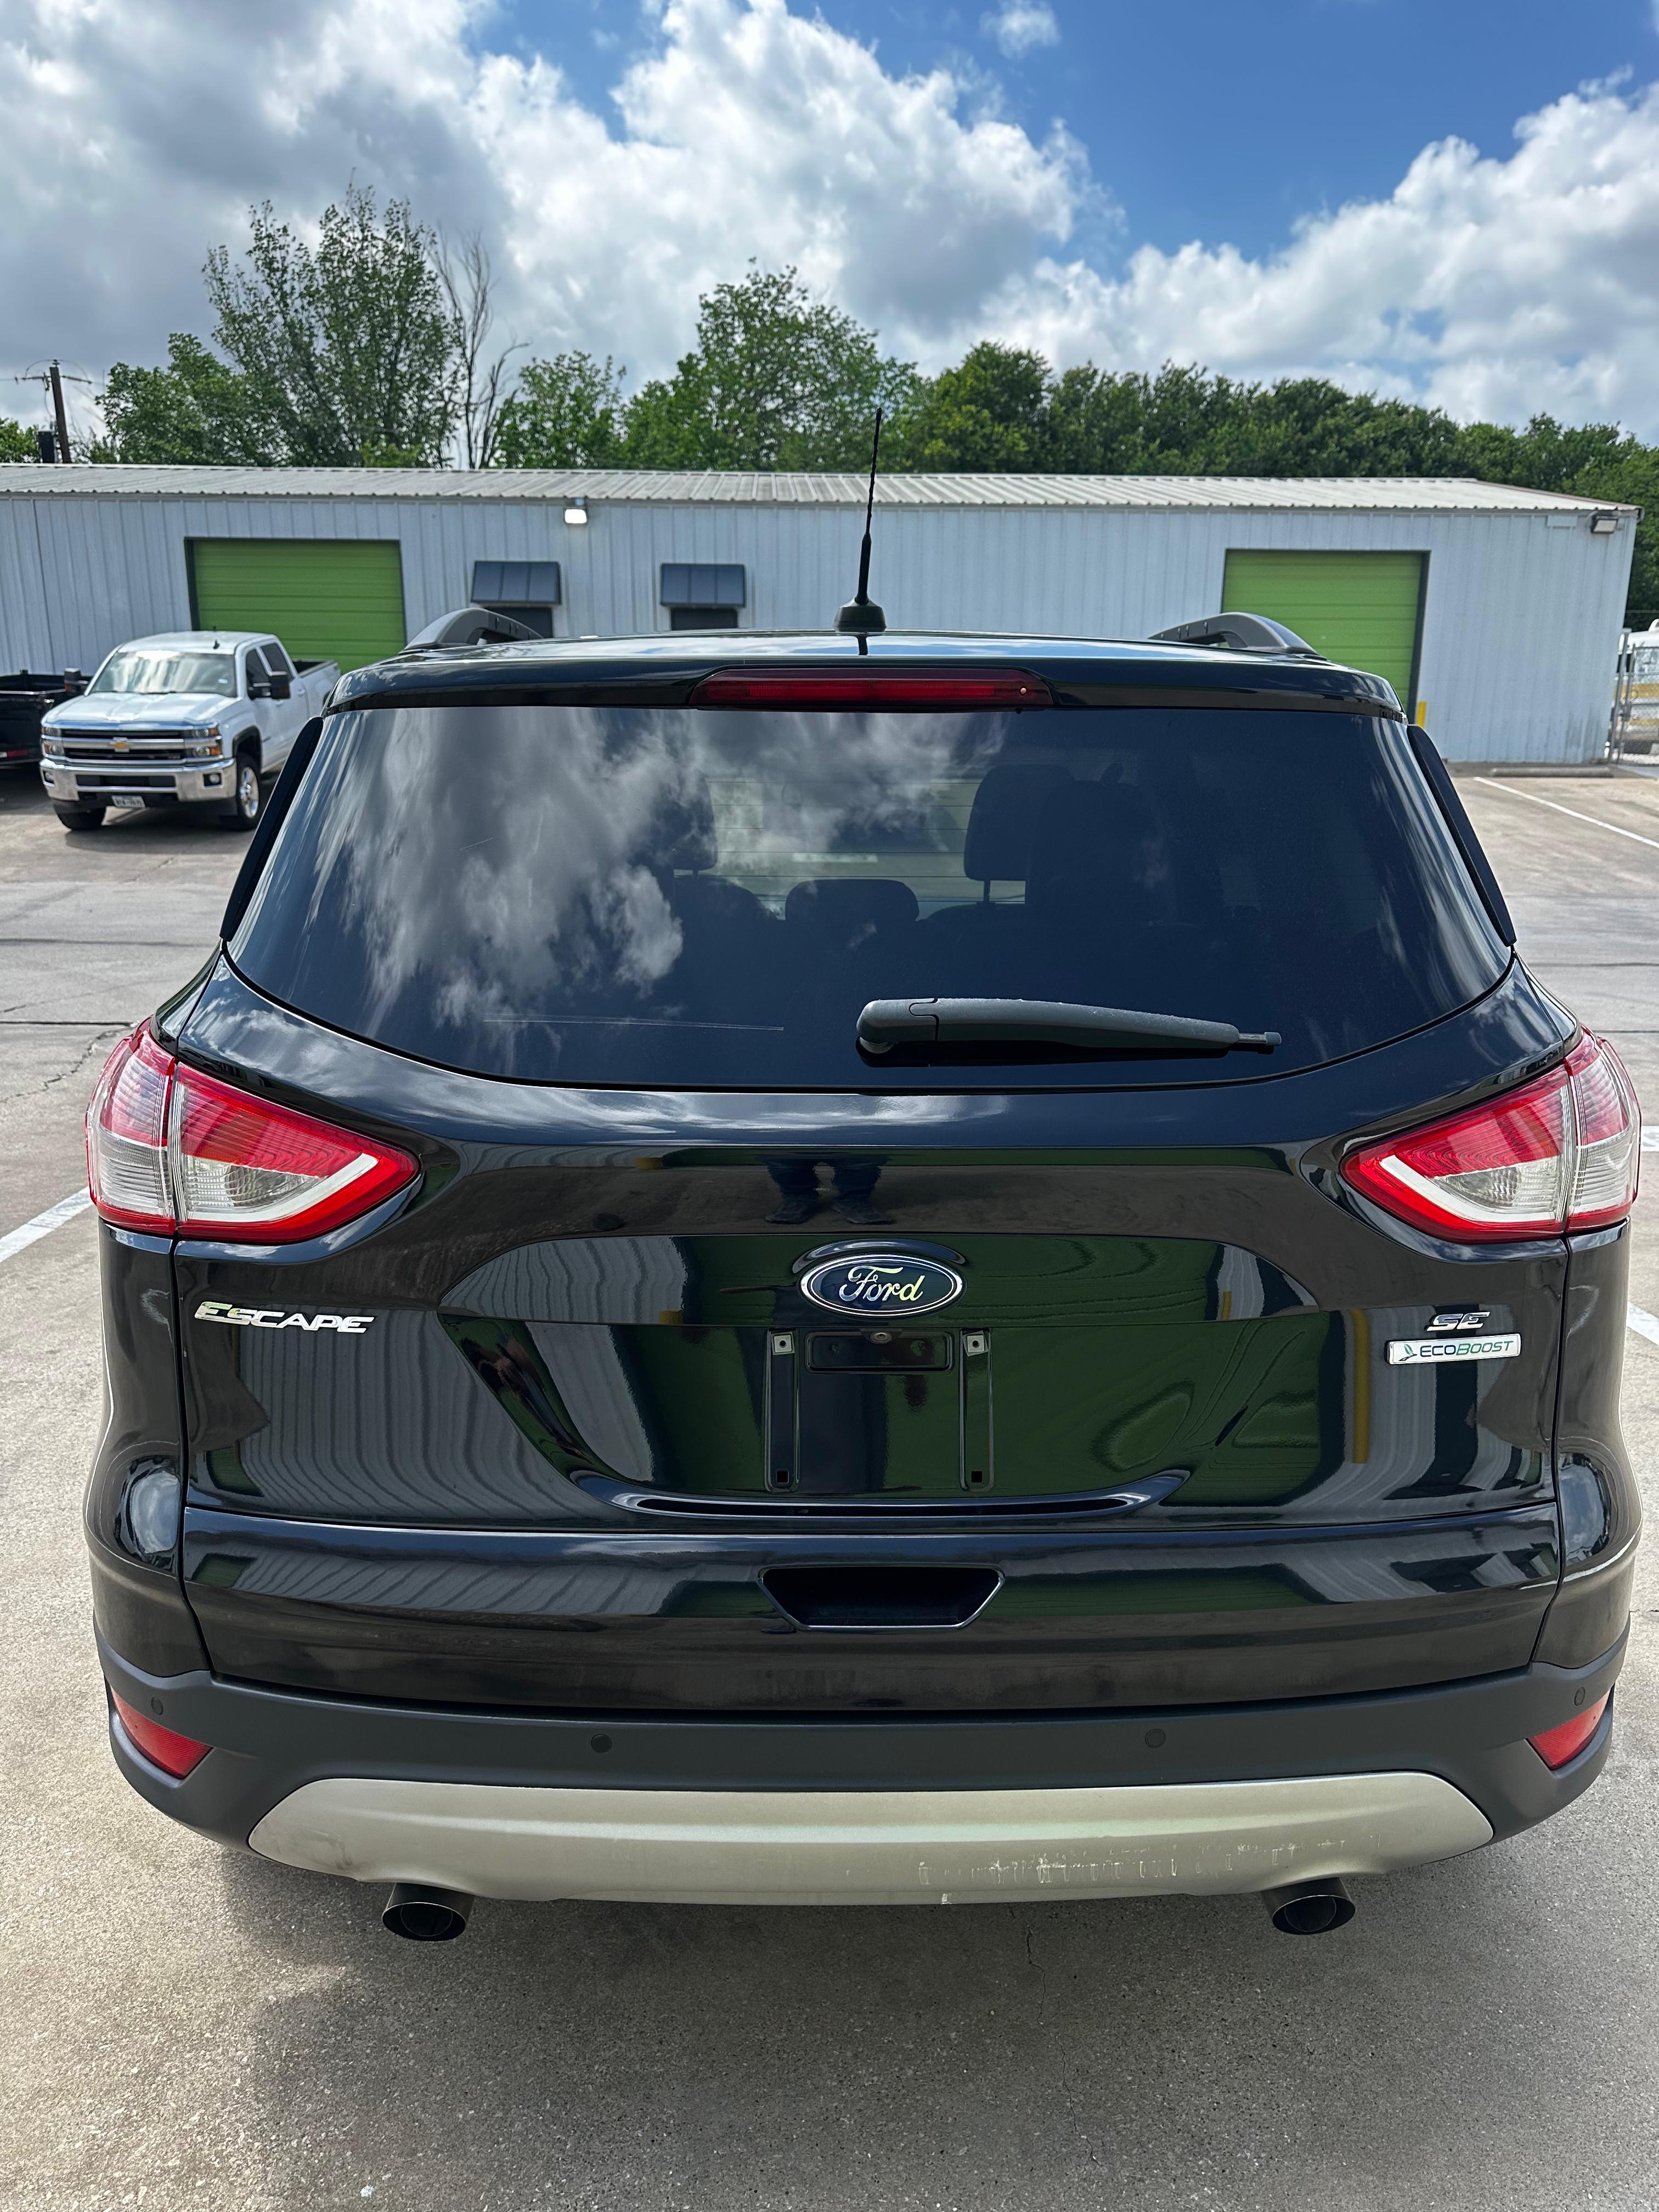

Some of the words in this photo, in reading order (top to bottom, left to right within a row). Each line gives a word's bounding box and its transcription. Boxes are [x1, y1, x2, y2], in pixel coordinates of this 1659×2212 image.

[839, 1265, 926, 1301] Ford
[194, 1301, 375, 1333] ESCAPE
[1426, 1311, 1491, 1331] SE
[1420, 1340, 1514, 1358] ECOBOOST
